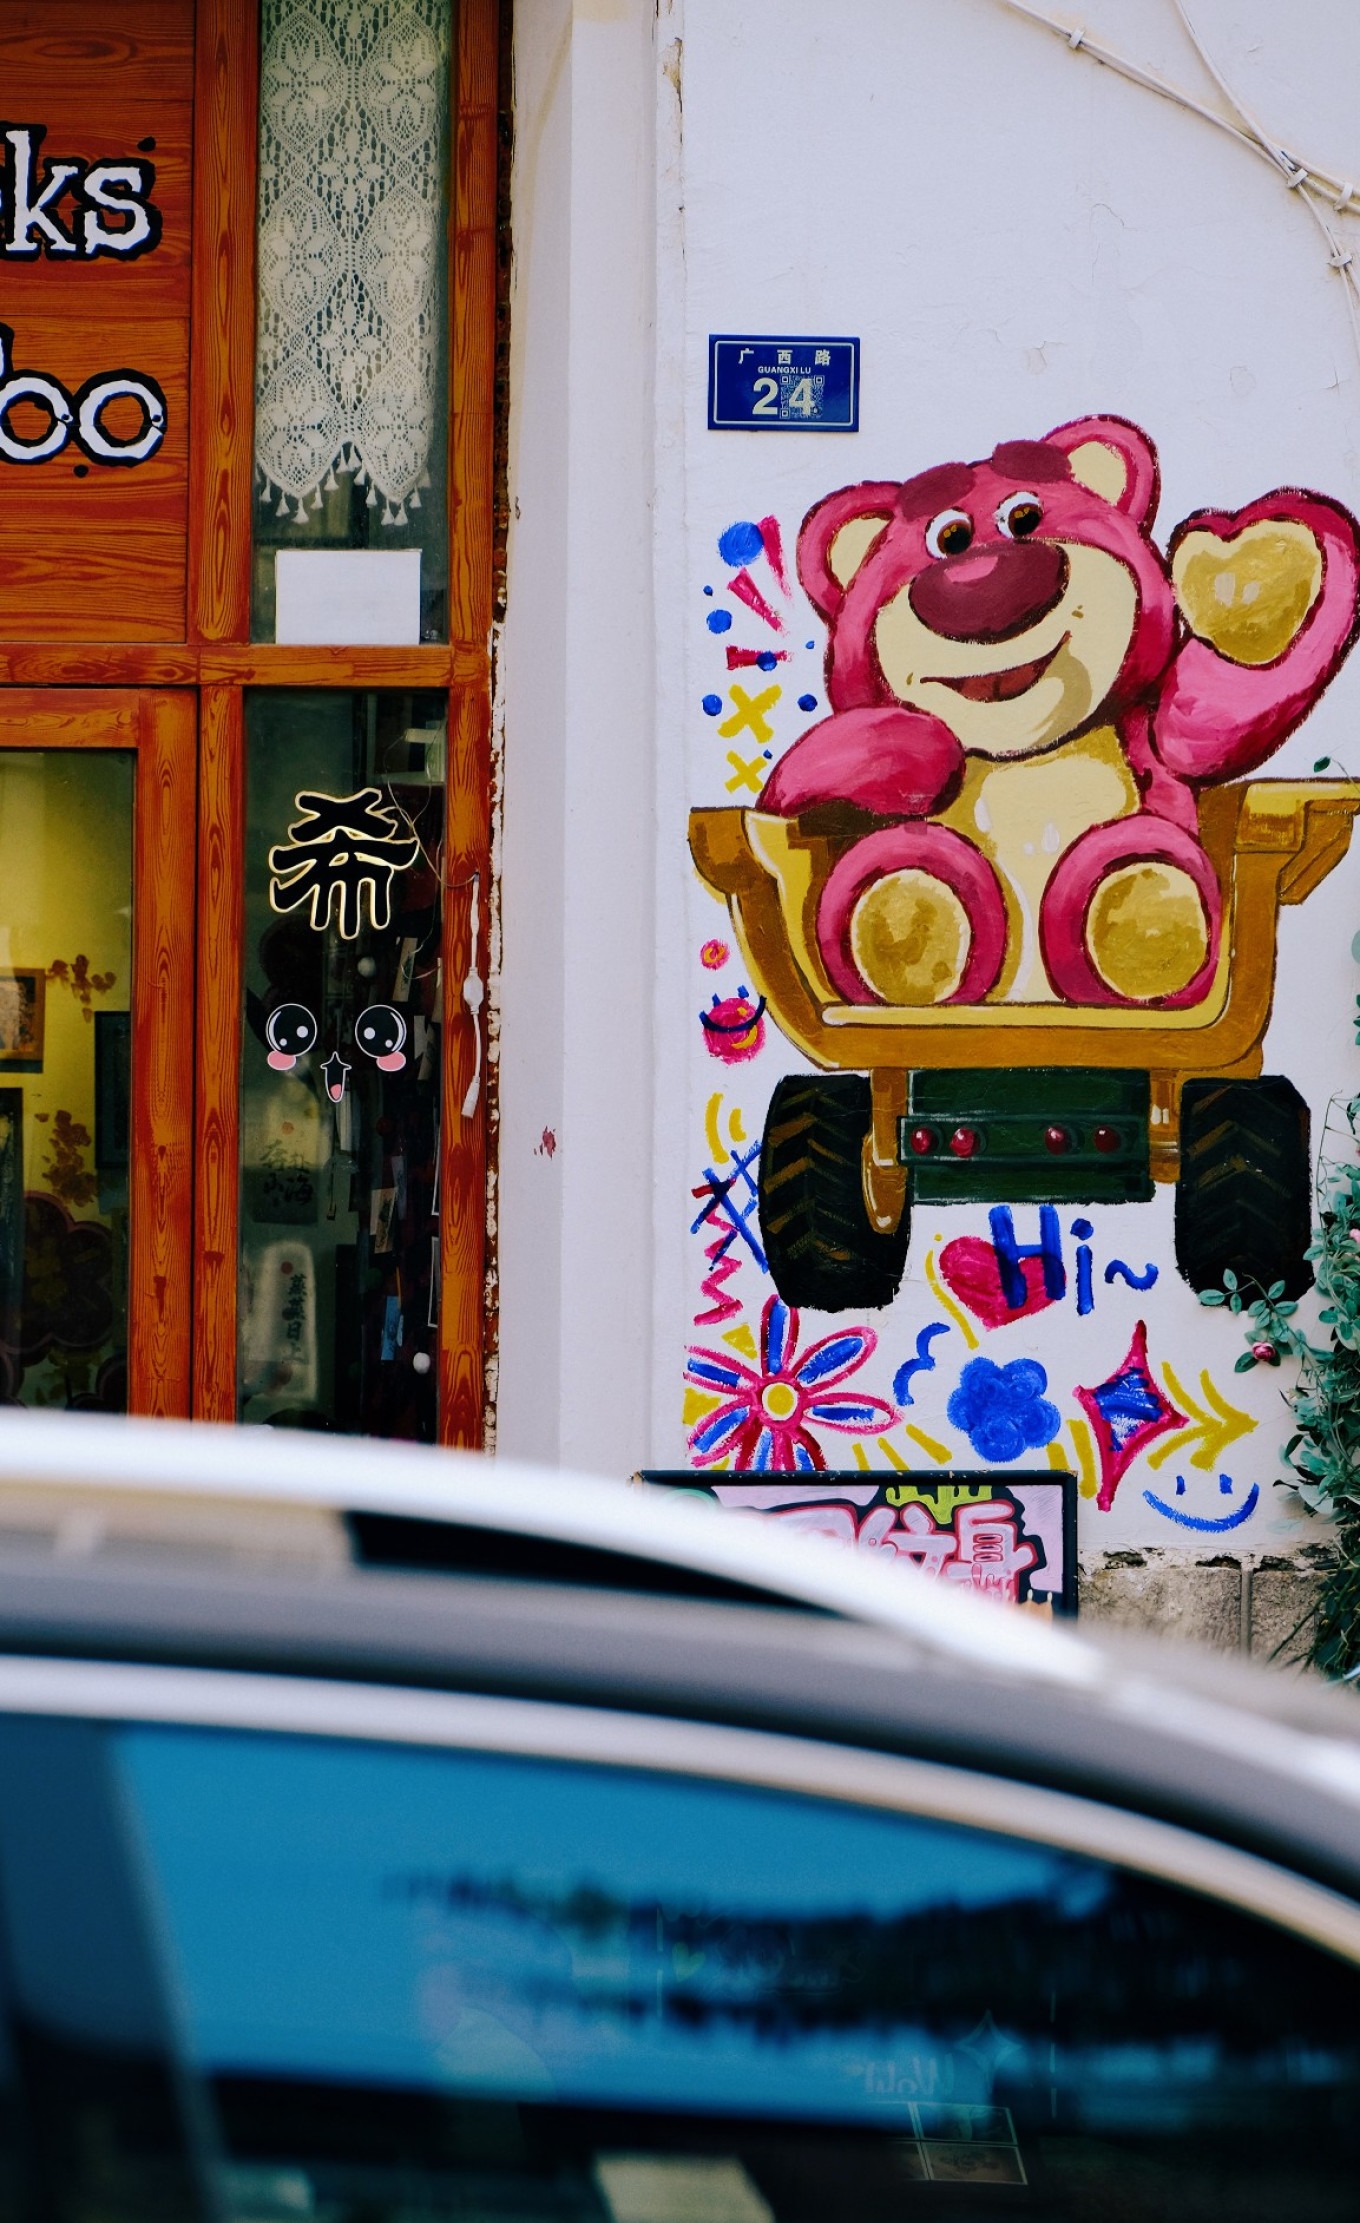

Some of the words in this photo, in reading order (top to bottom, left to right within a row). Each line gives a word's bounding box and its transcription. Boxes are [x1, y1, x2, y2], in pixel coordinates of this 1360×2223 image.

[0, 128, 154, 256] ks
[738, 348, 831, 366] 广西路
[757, 366, 798, 374] GUANGXI
[800, 366, 811, 374] LU
[752, 377, 812, 415] 24
[269, 787, 420, 940] 希
